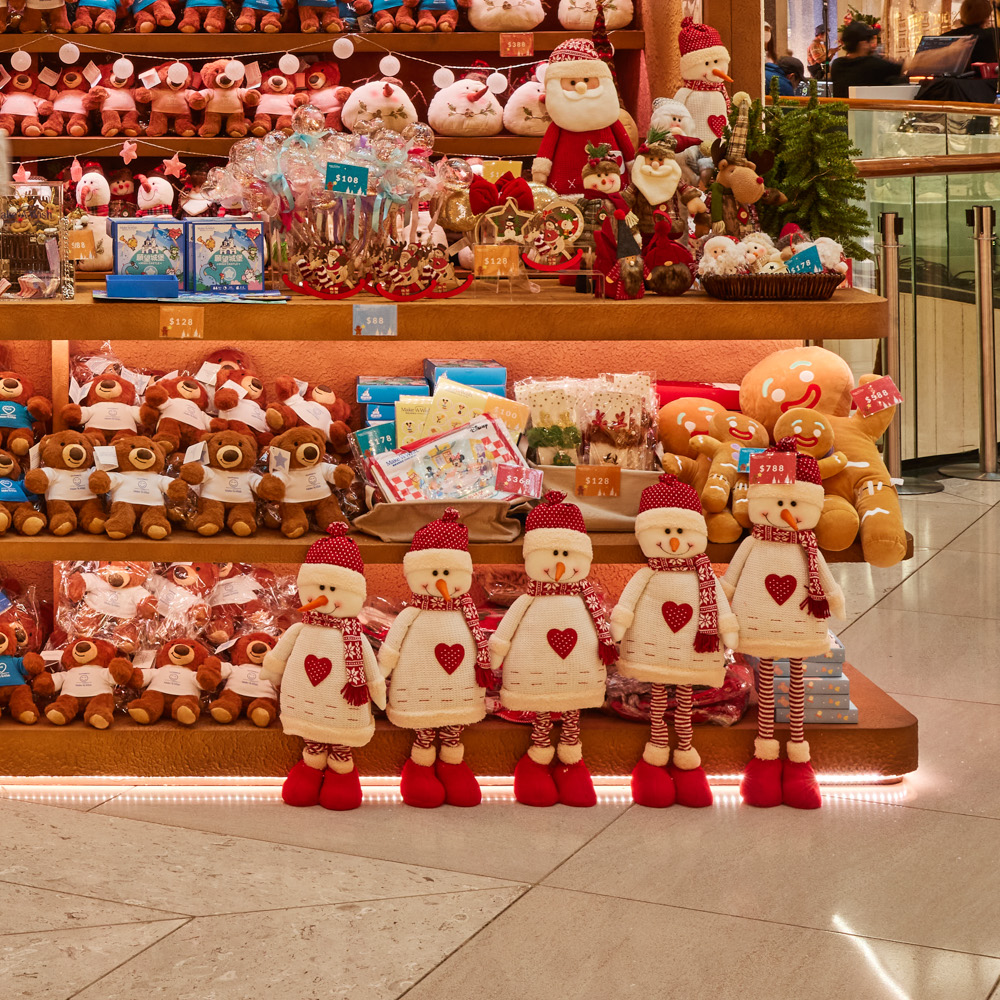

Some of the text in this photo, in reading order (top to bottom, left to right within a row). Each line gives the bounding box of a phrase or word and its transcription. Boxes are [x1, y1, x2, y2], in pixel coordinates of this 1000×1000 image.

[335, 173, 359, 184] $108
[484, 257, 508, 265] $128
[791, 259, 811, 273] $178
[169, 317, 193, 326] $128
[366, 316, 384, 325] $88
[494, 406, 518, 419] $100
[368, 434, 392, 448] $178
[760, 464, 784, 473] $788
[506, 474, 531, 485] $368
[585, 476, 610, 485] $128
